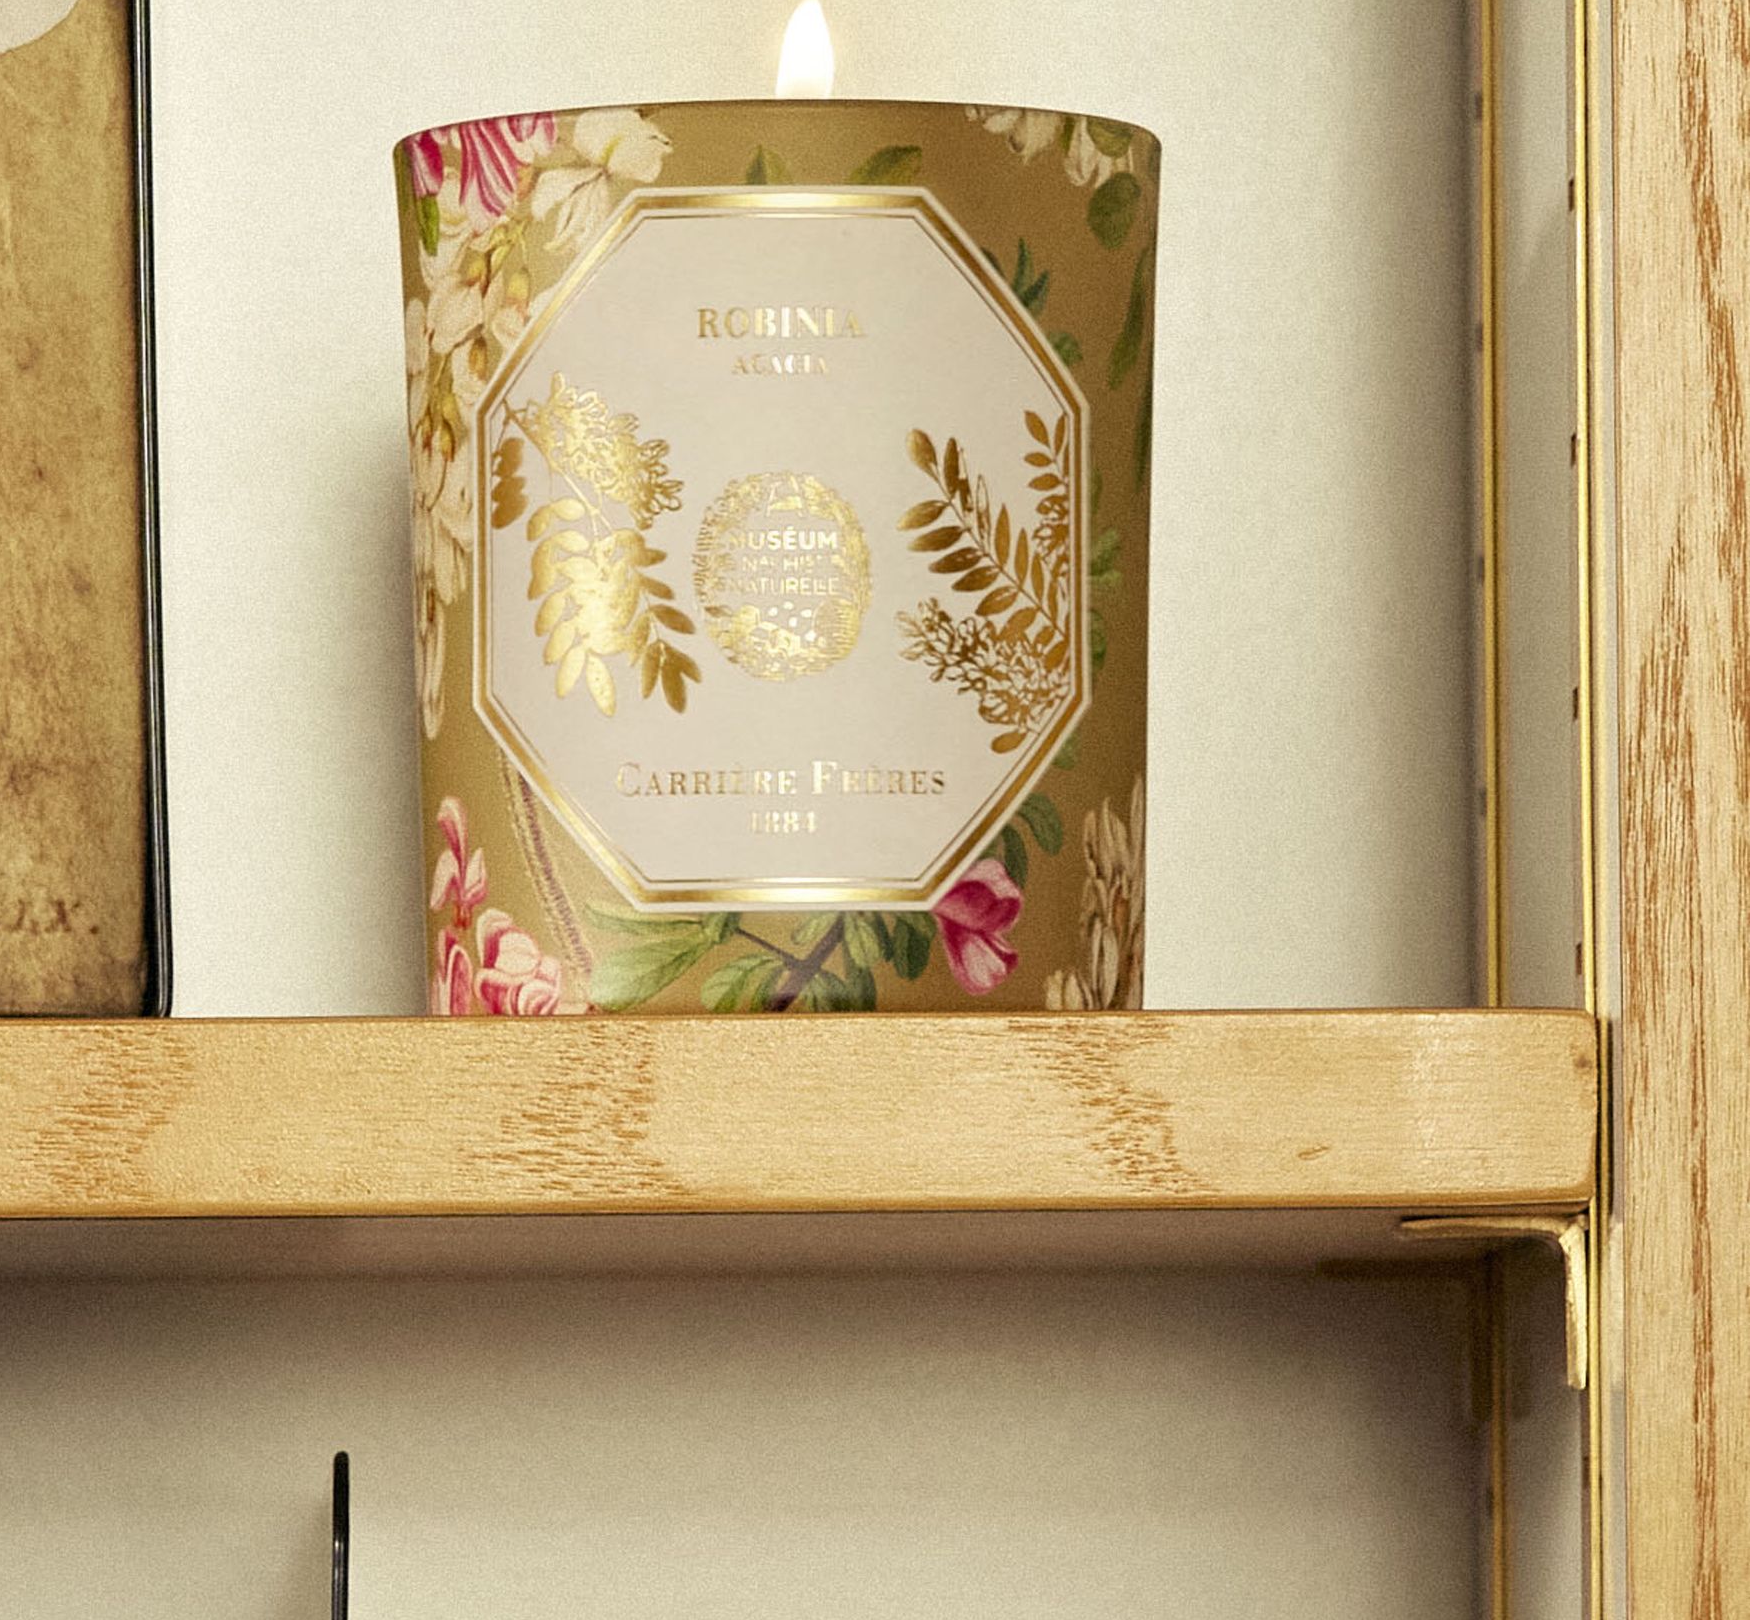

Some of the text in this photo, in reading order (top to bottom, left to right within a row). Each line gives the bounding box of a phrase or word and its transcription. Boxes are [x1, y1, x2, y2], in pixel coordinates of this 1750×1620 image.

[696, 305, 869, 339] ROBINIA
[731, 353, 830, 375] ACACIA
[728, 524, 838, 551] MUSÉUM
